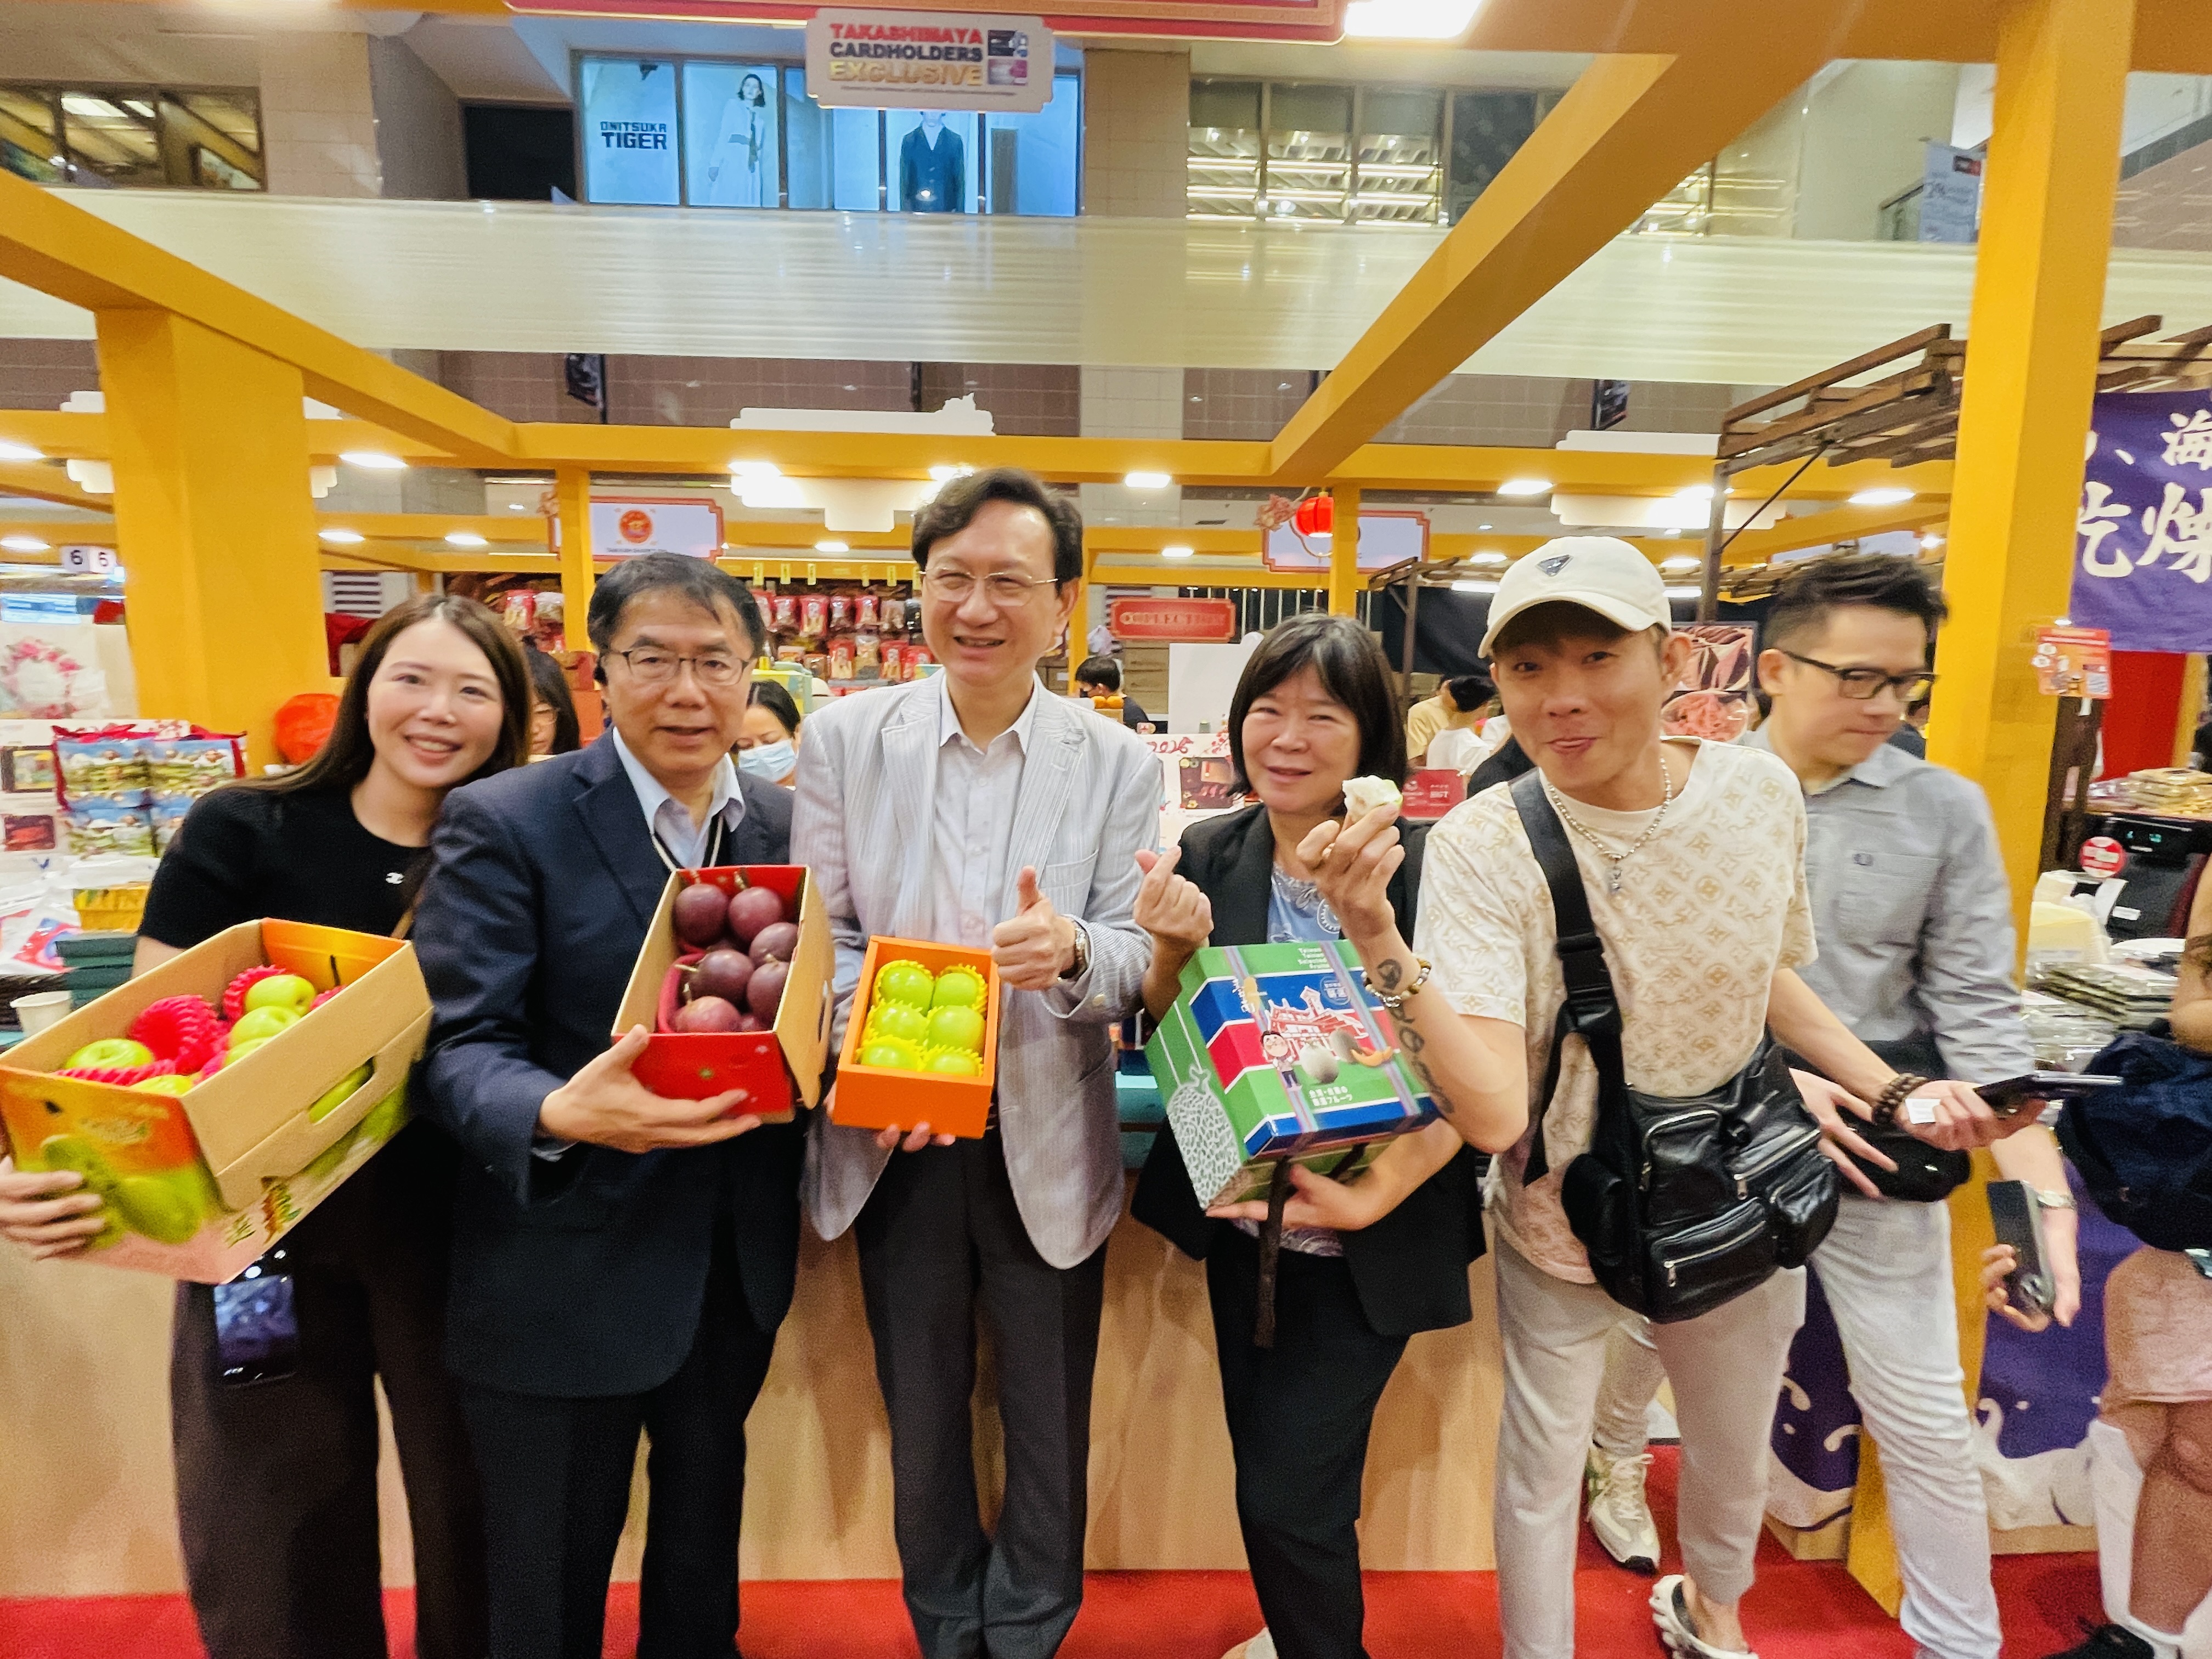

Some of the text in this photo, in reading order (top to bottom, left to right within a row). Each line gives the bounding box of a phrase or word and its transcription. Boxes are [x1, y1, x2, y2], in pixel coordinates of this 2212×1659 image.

[829, 23, 984, 44] TAKASHIMAYA
[830, 42, 984, 62] CARDHOLDERS
[829, 60, 984, 86] EXCLUSIVE
[600, 121, 667, 132] ONITSUKA
[601, 132, 667, 150] TIGER
